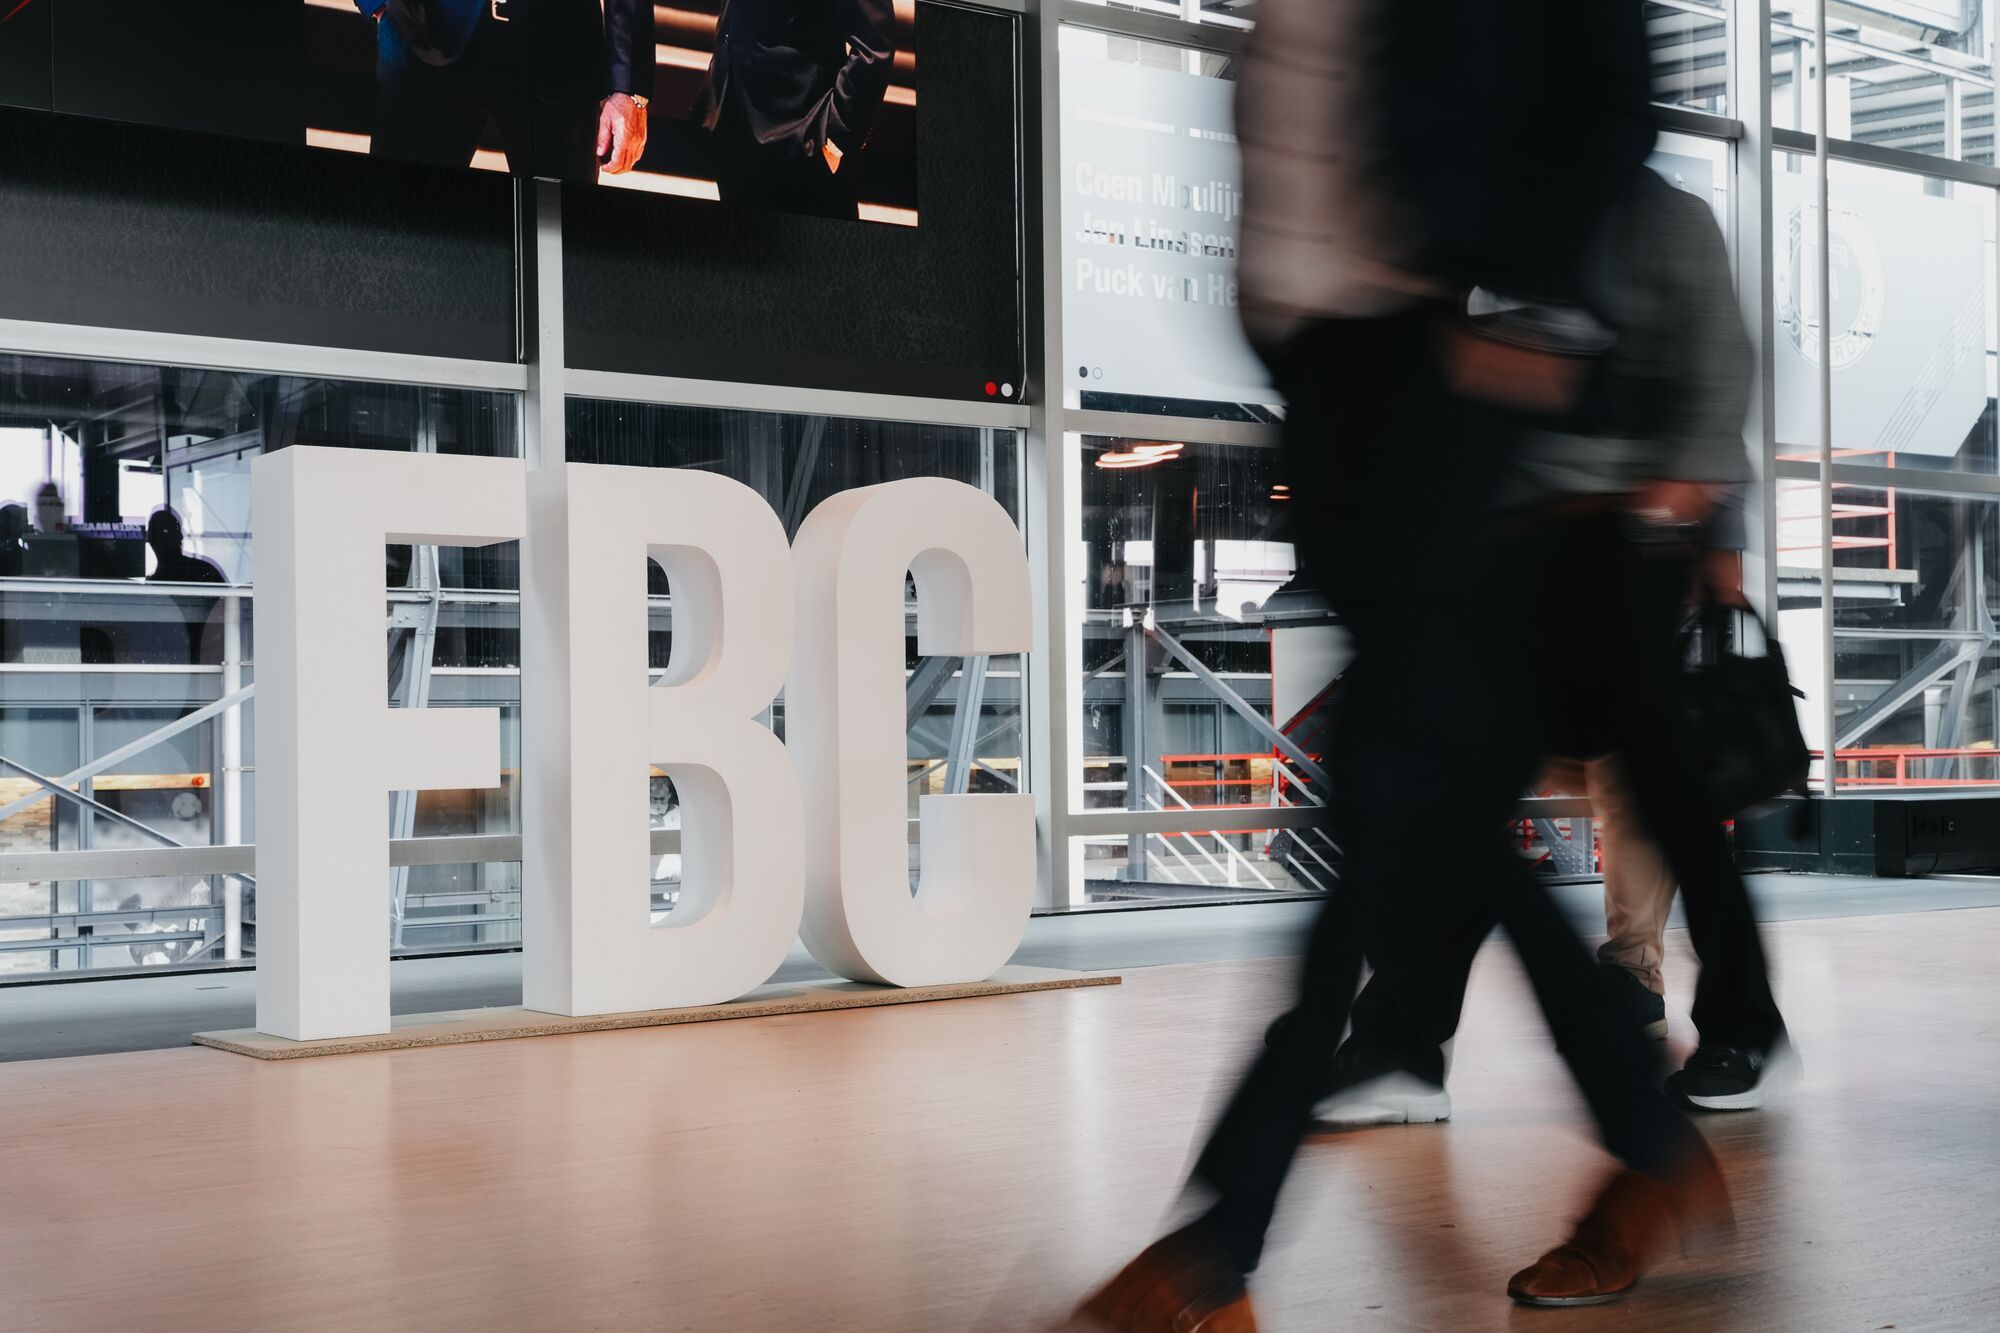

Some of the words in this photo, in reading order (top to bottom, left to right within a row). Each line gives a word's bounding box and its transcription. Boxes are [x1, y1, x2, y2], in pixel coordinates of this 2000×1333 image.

[1075, 161, 1143, 203] Coen
[1075, 210, 1125, 246] Jan
[1134, 216, 1235, 259] Linssen
[1075, 257, 1145, 298] Puck
[1152, 273, 1199, 302] van
[252, 445, 1037, 1042] FBC
